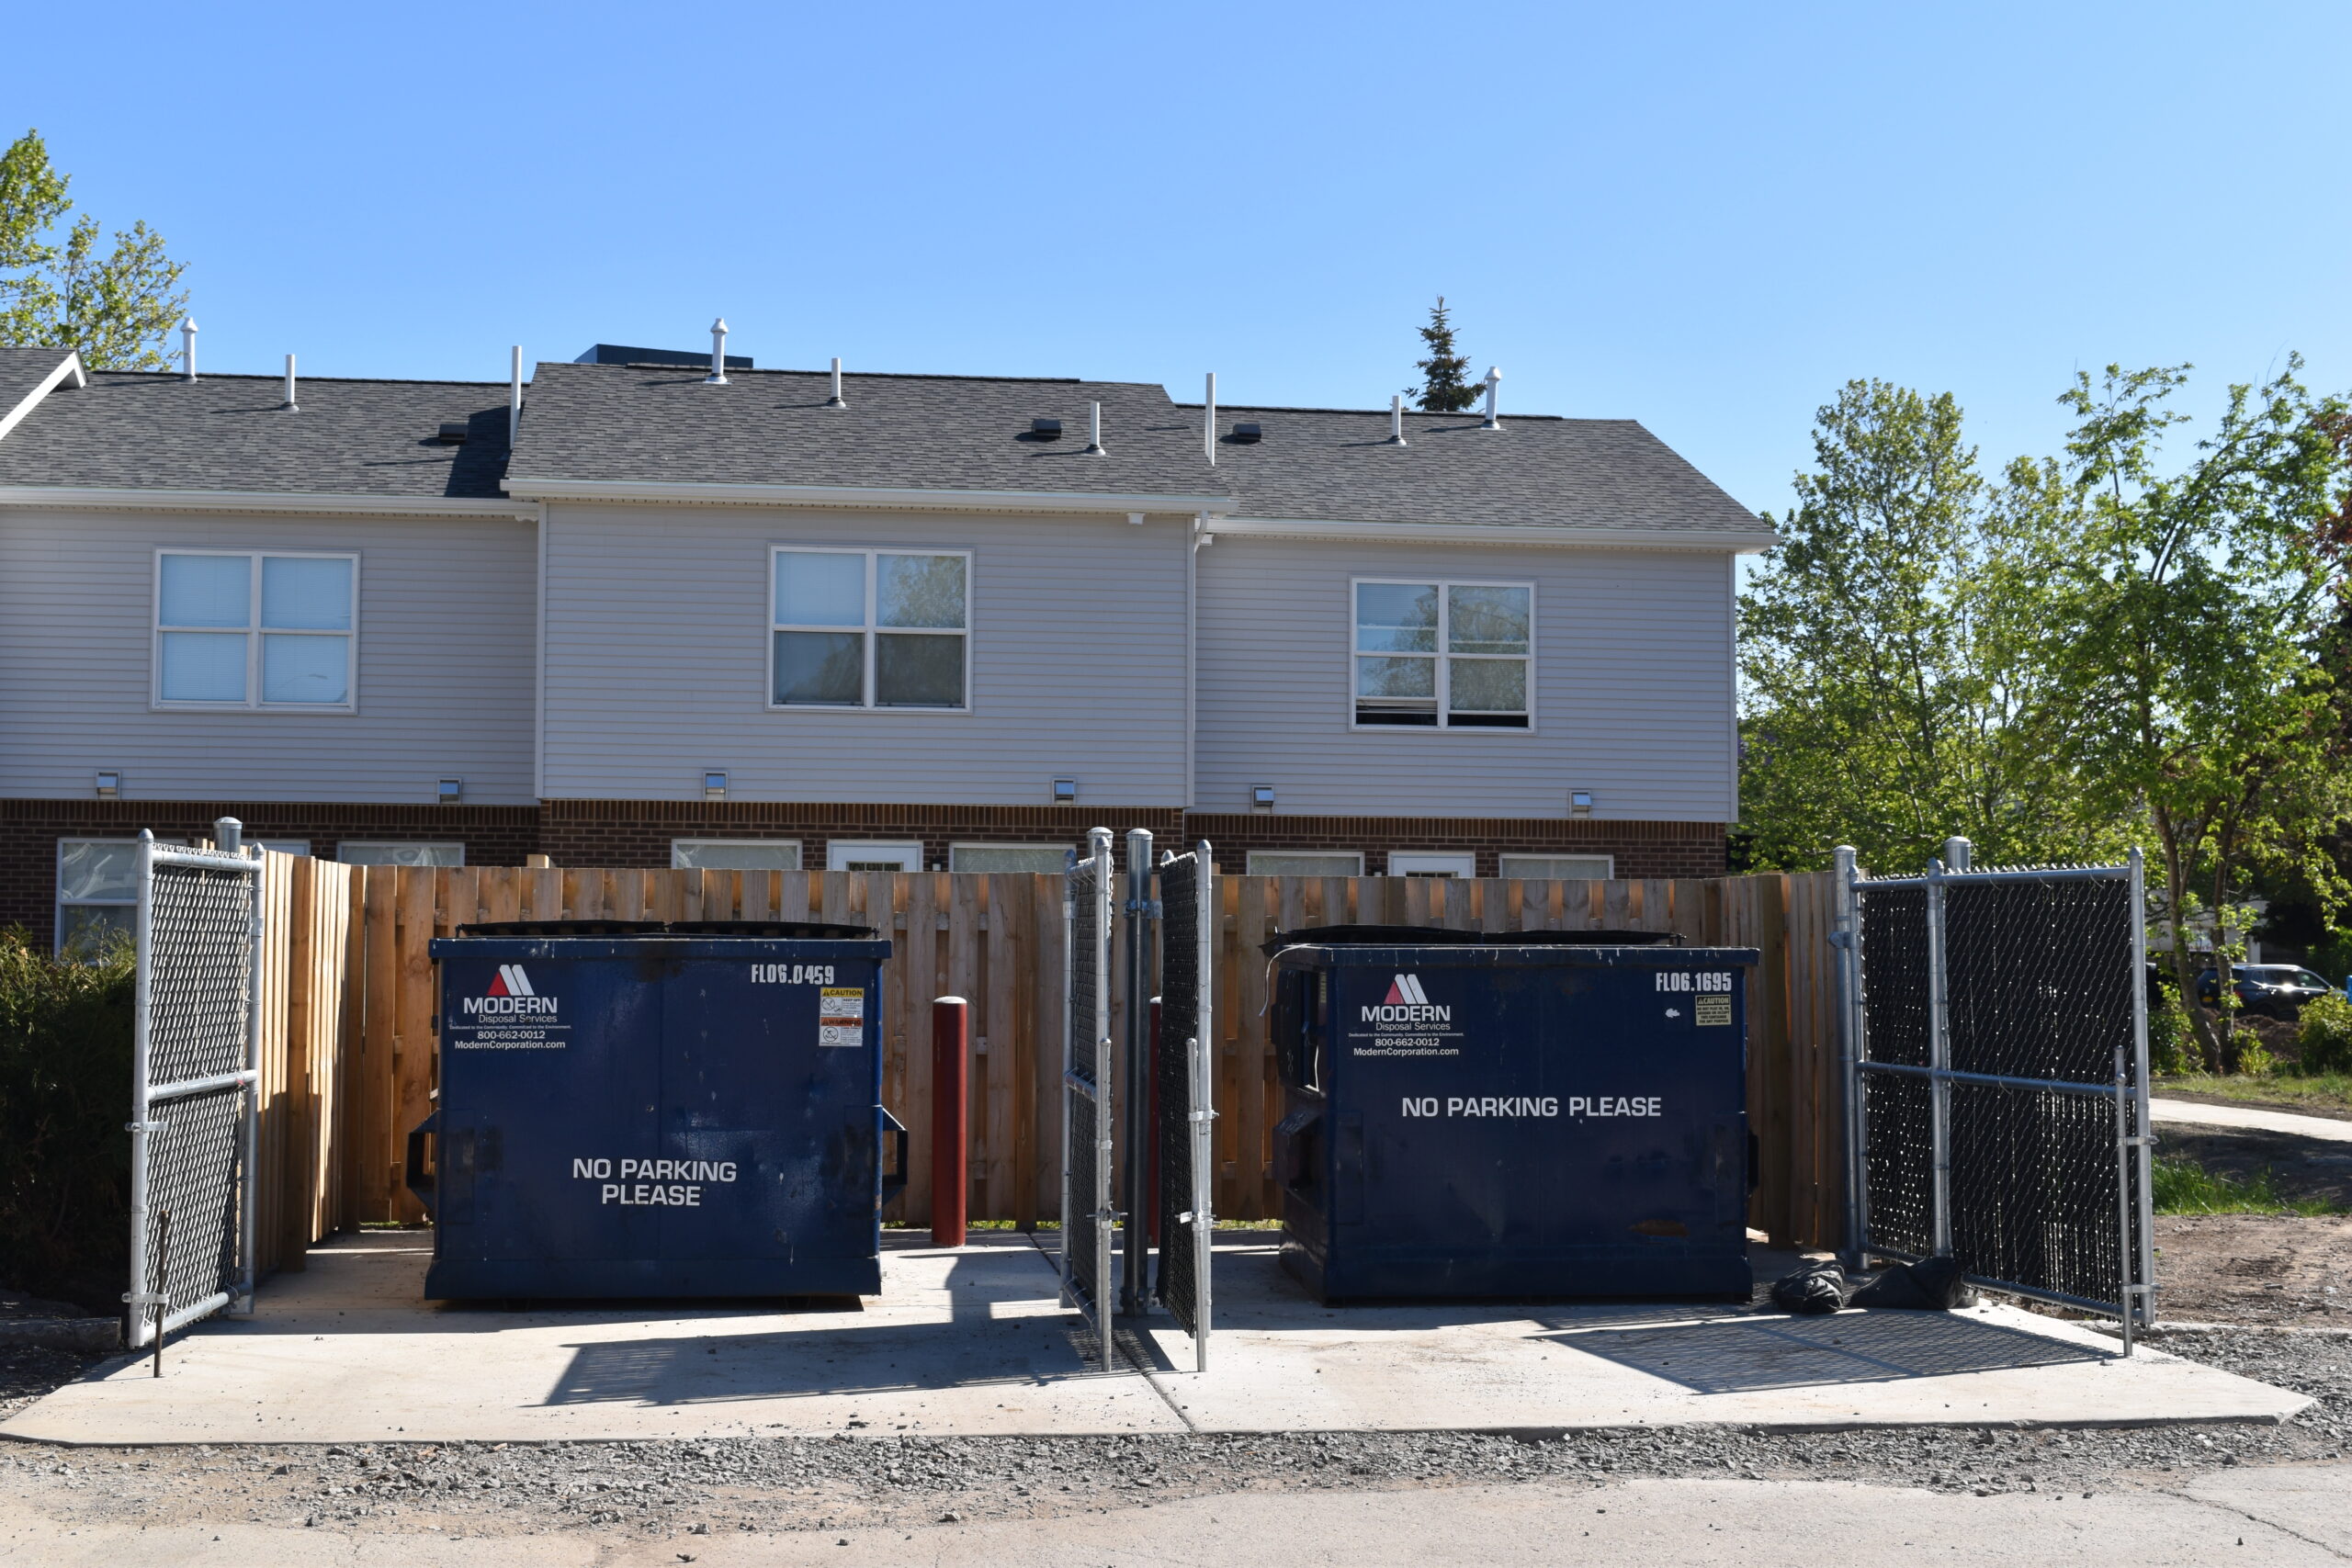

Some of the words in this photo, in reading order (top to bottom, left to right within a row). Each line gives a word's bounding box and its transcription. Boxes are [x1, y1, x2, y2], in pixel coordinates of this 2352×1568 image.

[751, 964, 835, 986] FL06.0459
[1656, 972, 1732, 992] FL06.1695
[464, 997, 558, 1014] MODERN
[1361, 1005, 1451, 1022] MODERN
[479, 1014, 516, 1024] Disposal
[519, 1014, 558, 1023] Services
[1376, 1022, 1412, 1032] Disposal
[1414, 1021, 1451, 1031] Services
[477, 1031, 546, 1040] 800-662-0012
[1374, 1037, 1441, 1047] 800-662-0012
[454, 1040, 566, 1050] ModernCorporation.com
[1353, 1047, 1459, 1057] ModernCorporation.com
[1402, 1097, 1439, 1117] NO
[1447, 1097, 1558, 1117] PARKING
[1569, 1097, 1662, 1117] PLEASE
[572, 1158, 612, 1179] NO
[620, 1158, 738, 1182] PARKING
[602, 1184, 701, 1206] PLEASE
